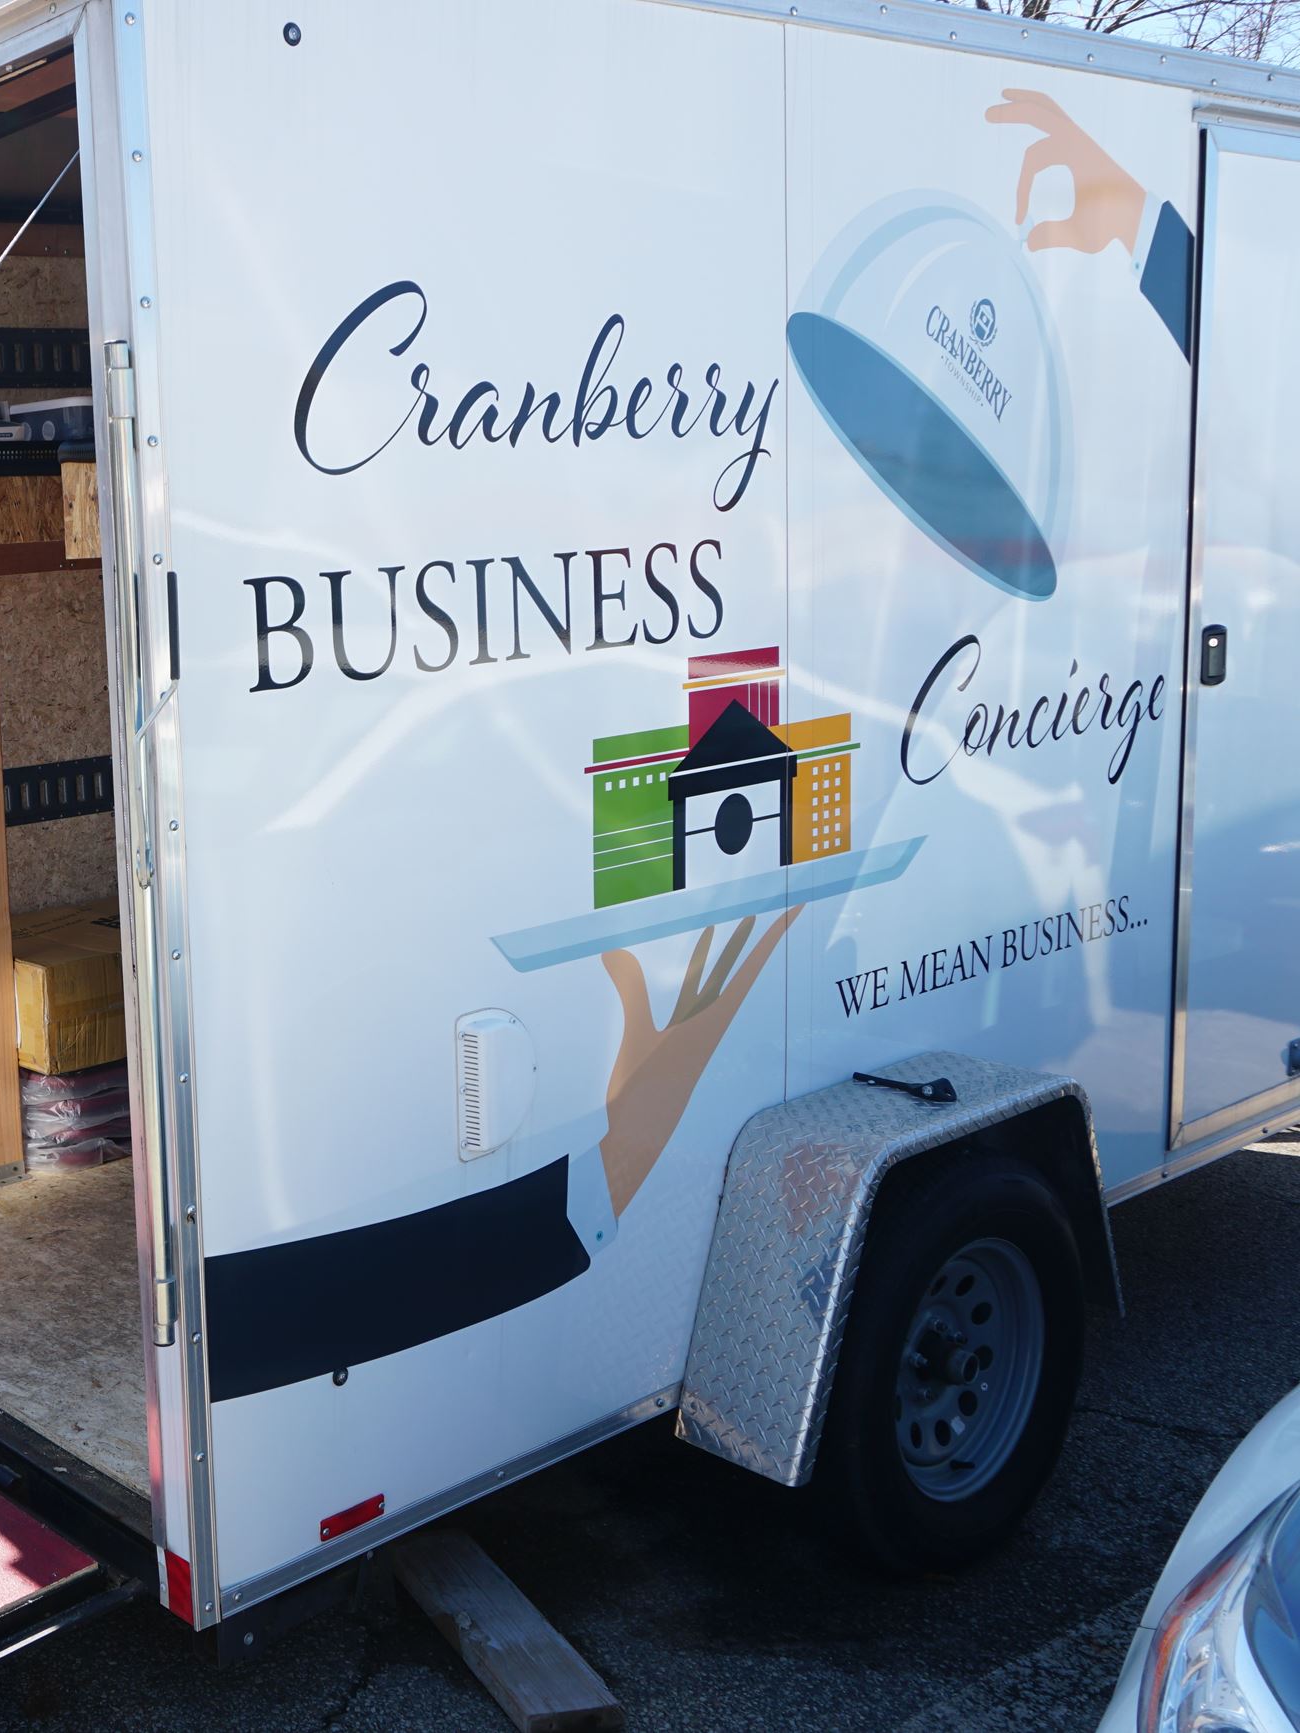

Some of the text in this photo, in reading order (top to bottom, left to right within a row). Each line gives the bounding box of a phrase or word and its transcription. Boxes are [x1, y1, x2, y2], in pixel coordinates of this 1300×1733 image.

[293, 279, 780, 513] Cranberry
[925, 304, 1012, 423] CRANBERRY
[943, 357, 983, 404] TOWNSHIP
[242, 538, 725, 694] BUSINESS
[899, 634, 1166, 786] Concierge
[835, 894, 1149, 1019] WE MEAN BUSINESS...
